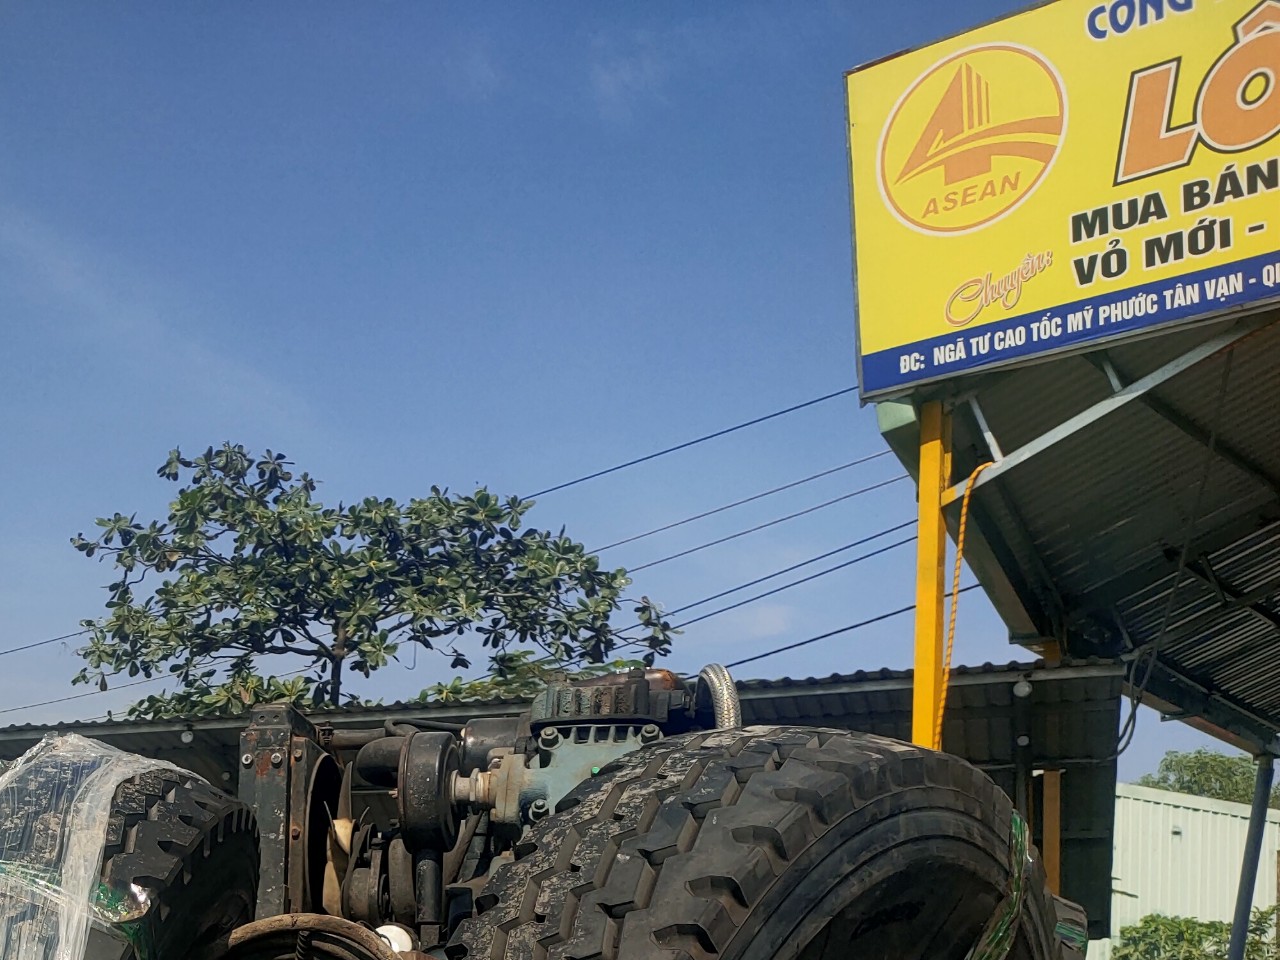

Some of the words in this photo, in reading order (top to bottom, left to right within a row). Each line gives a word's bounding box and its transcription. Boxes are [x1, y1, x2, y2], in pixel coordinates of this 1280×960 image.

[921, 171, 1021, 219] ASEAN
[1072, 191, 1168, 243] MUA
[1182, 158, 1279, 213] BÁN
[1074, 238, 1128, 286] VỎ
[1144, 217, 1232, 268] MỚI
[899, 352, 926, 374] ĐC:
[933, 337, 967, 366] NGÃ
[970, 332, 992, 357] TƯ
[993, 326, 1026, 351] CAO
[1030, 312, 1063, 342] TỐC
[1067, 304, 1094, 334] MỸ
[1098, 292, 1158, 326] PHƯỚC
[1163, 282, 1200, 310] TÂN
[1204, 272, 1243, 302] VẠN
